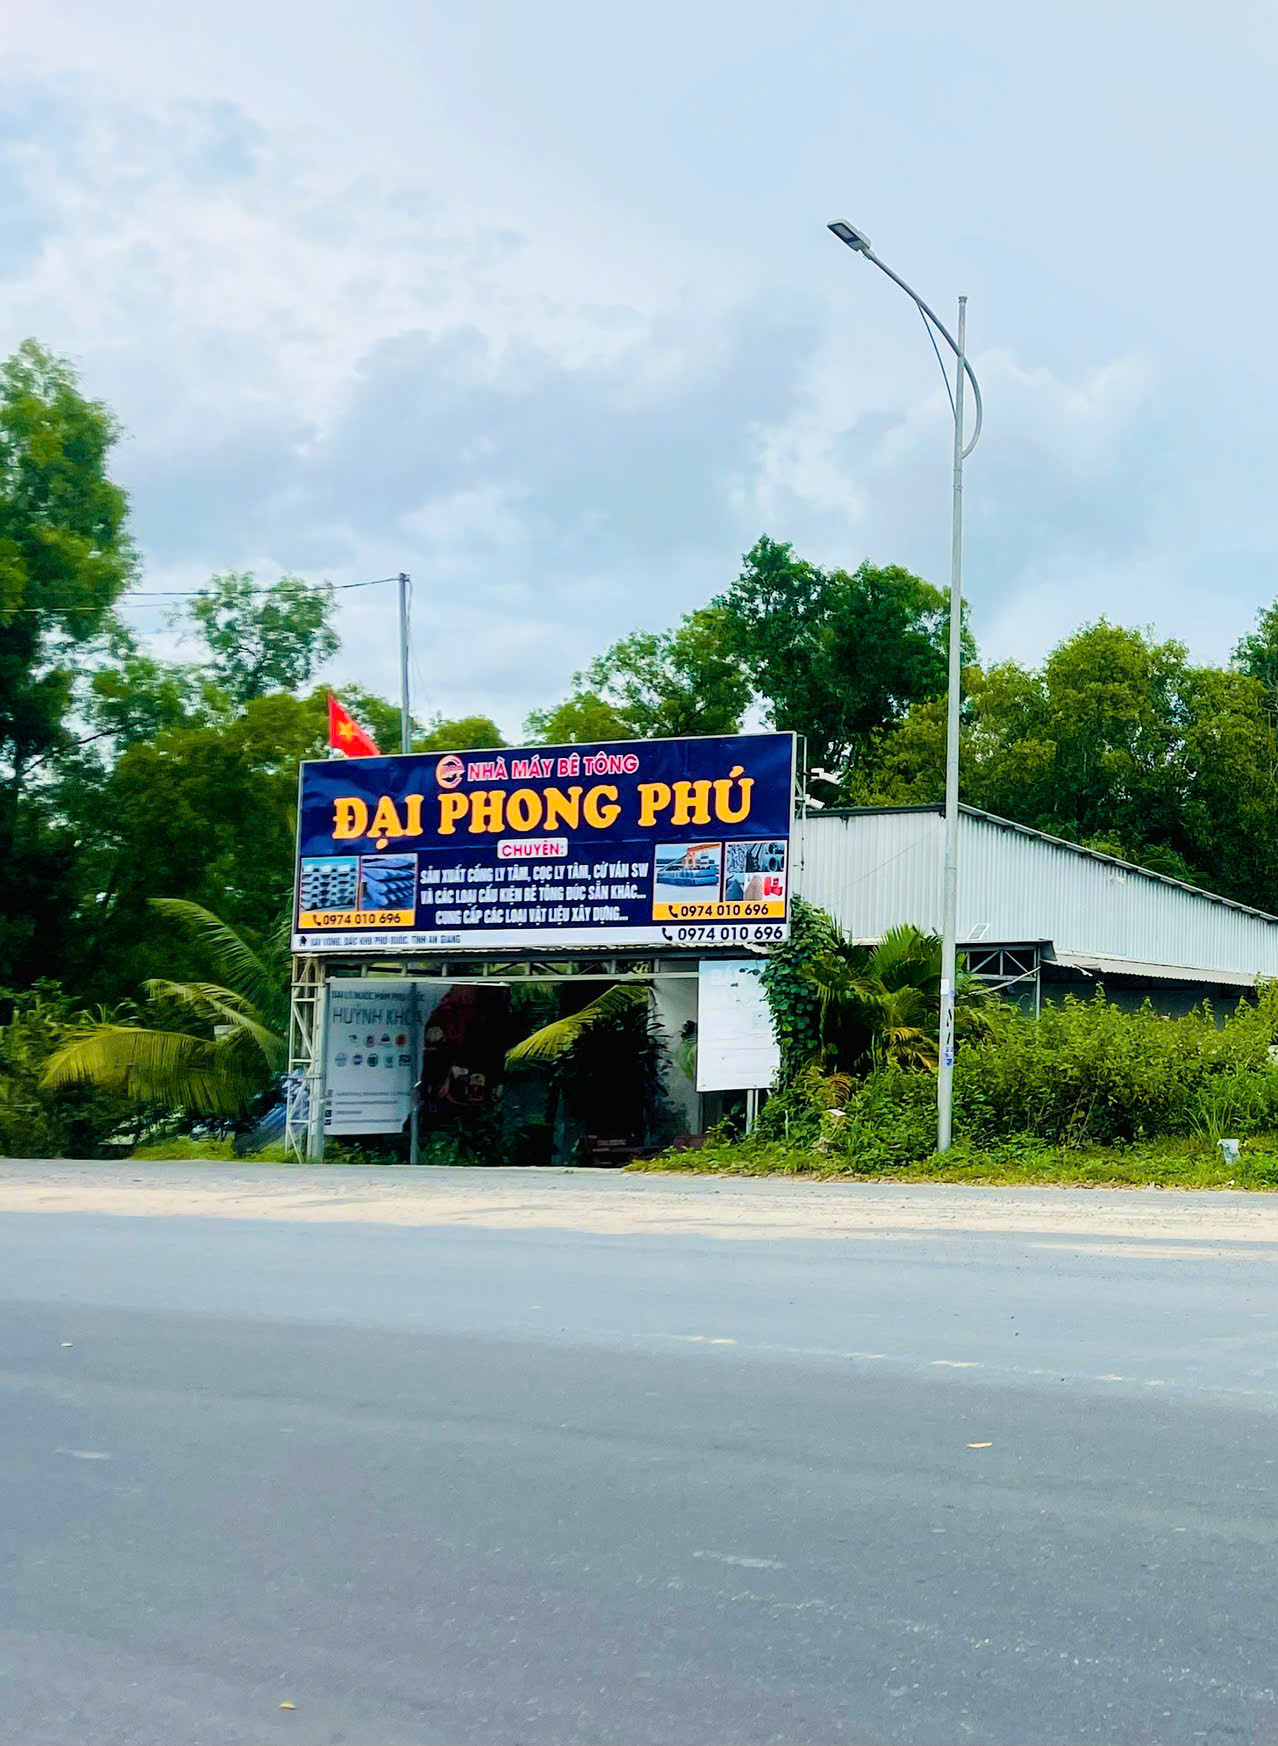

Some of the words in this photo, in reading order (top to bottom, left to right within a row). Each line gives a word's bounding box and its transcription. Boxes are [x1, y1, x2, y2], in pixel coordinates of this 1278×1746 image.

[467, 756, 508, 781] NHÀ
[511, 754, 553, 779] MÁY
[557, 753, 580, 777] BÊ
[583, 751, 639, 775] TÔNG
[332, 794, 424, 850] ĐẠI
[437, 783, 621, 835] PHONG
[637, 765, 755, 827] PHÚ
[502, 840, 564, 857] CHUYÊN:
[554, 865, 565, 880] LY
[631, 863, 649, 878] SW
[681, 905, 713, 917] 0974
[717, 904, 740, 916] 010
[744, 904, 769, 916] 696
[323, 914, 351, 926] 0974
[355, 914, 376, 924] 010
[379, 913, 401, 924] 696
[678, 927, 715, 940] 0974
[720, 926, 749, 940] 010
[754, 926, 783, 940] 696
